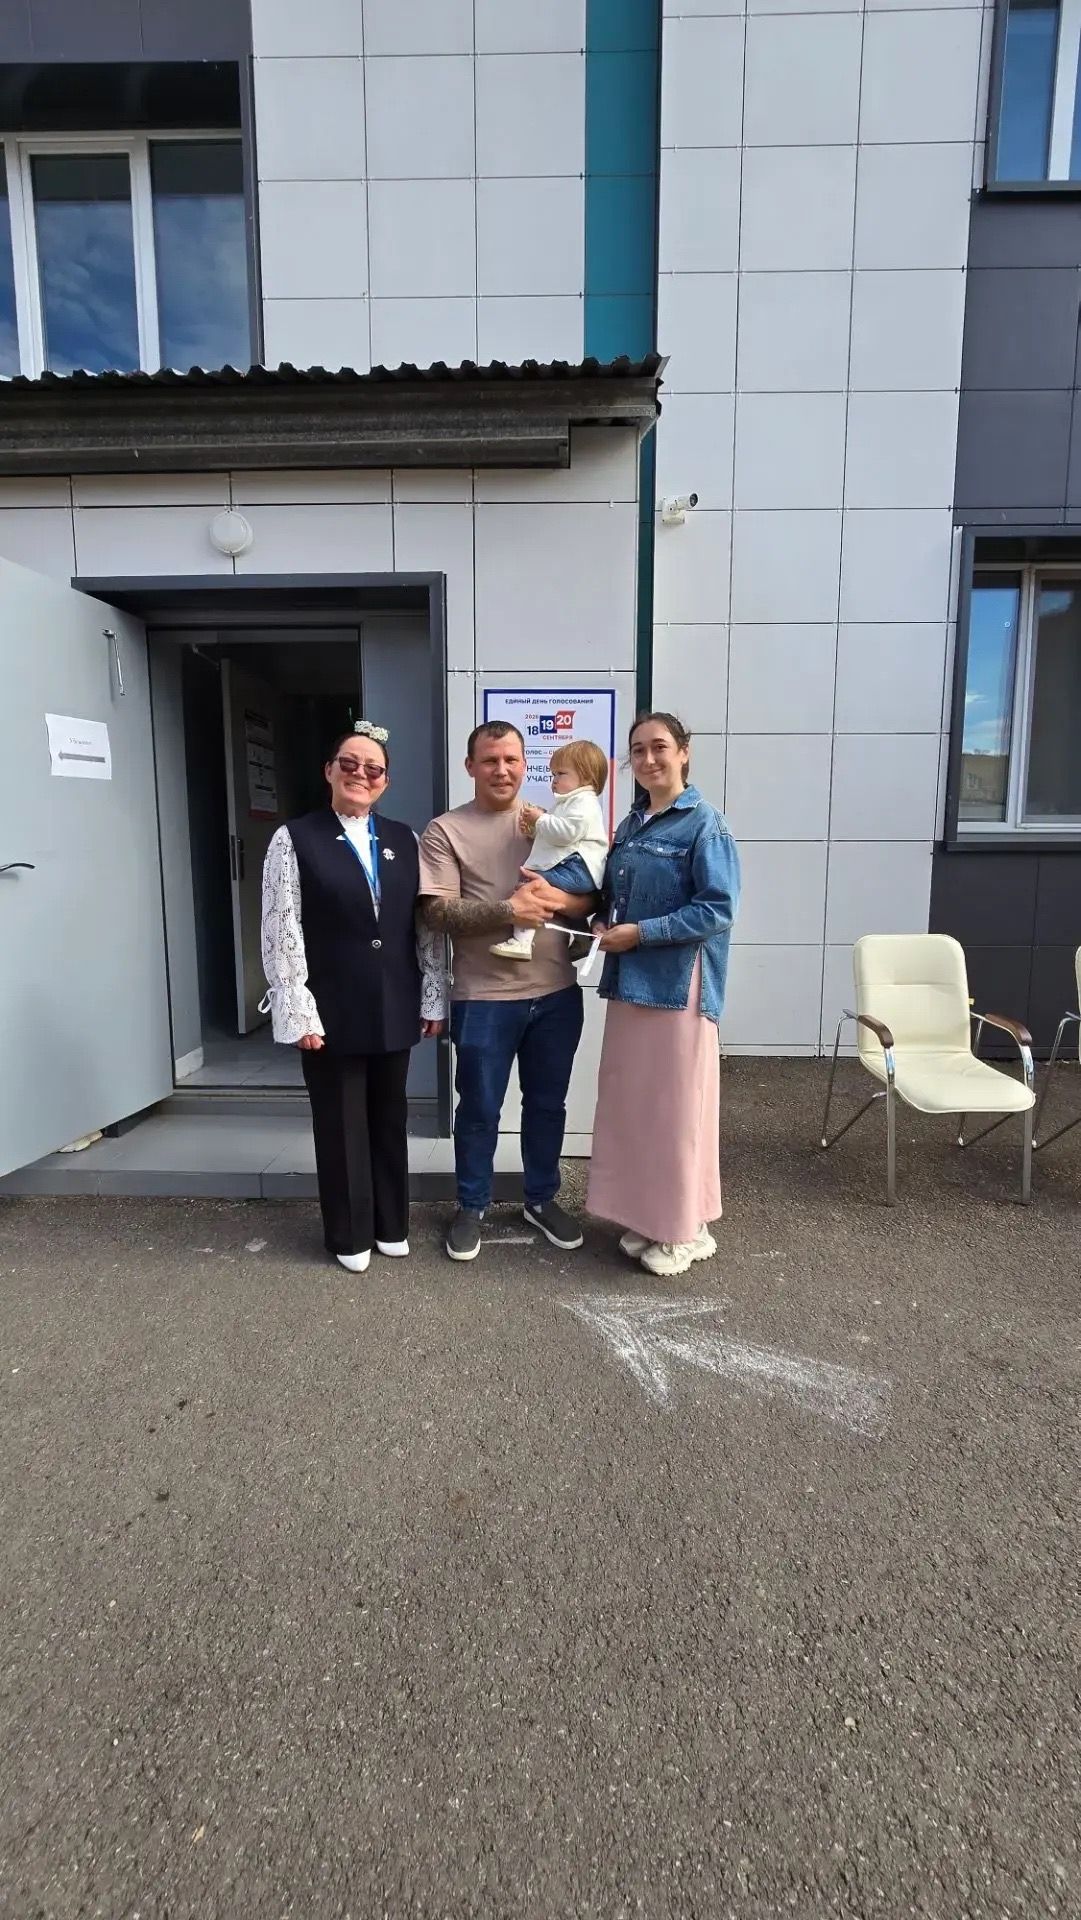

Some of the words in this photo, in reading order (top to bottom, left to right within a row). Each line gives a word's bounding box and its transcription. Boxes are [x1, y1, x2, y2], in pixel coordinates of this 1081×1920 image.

[527, 726, 539, 735] 18
[541, 720, 554, 730] 19
[556, 714, 572, 725] 20
